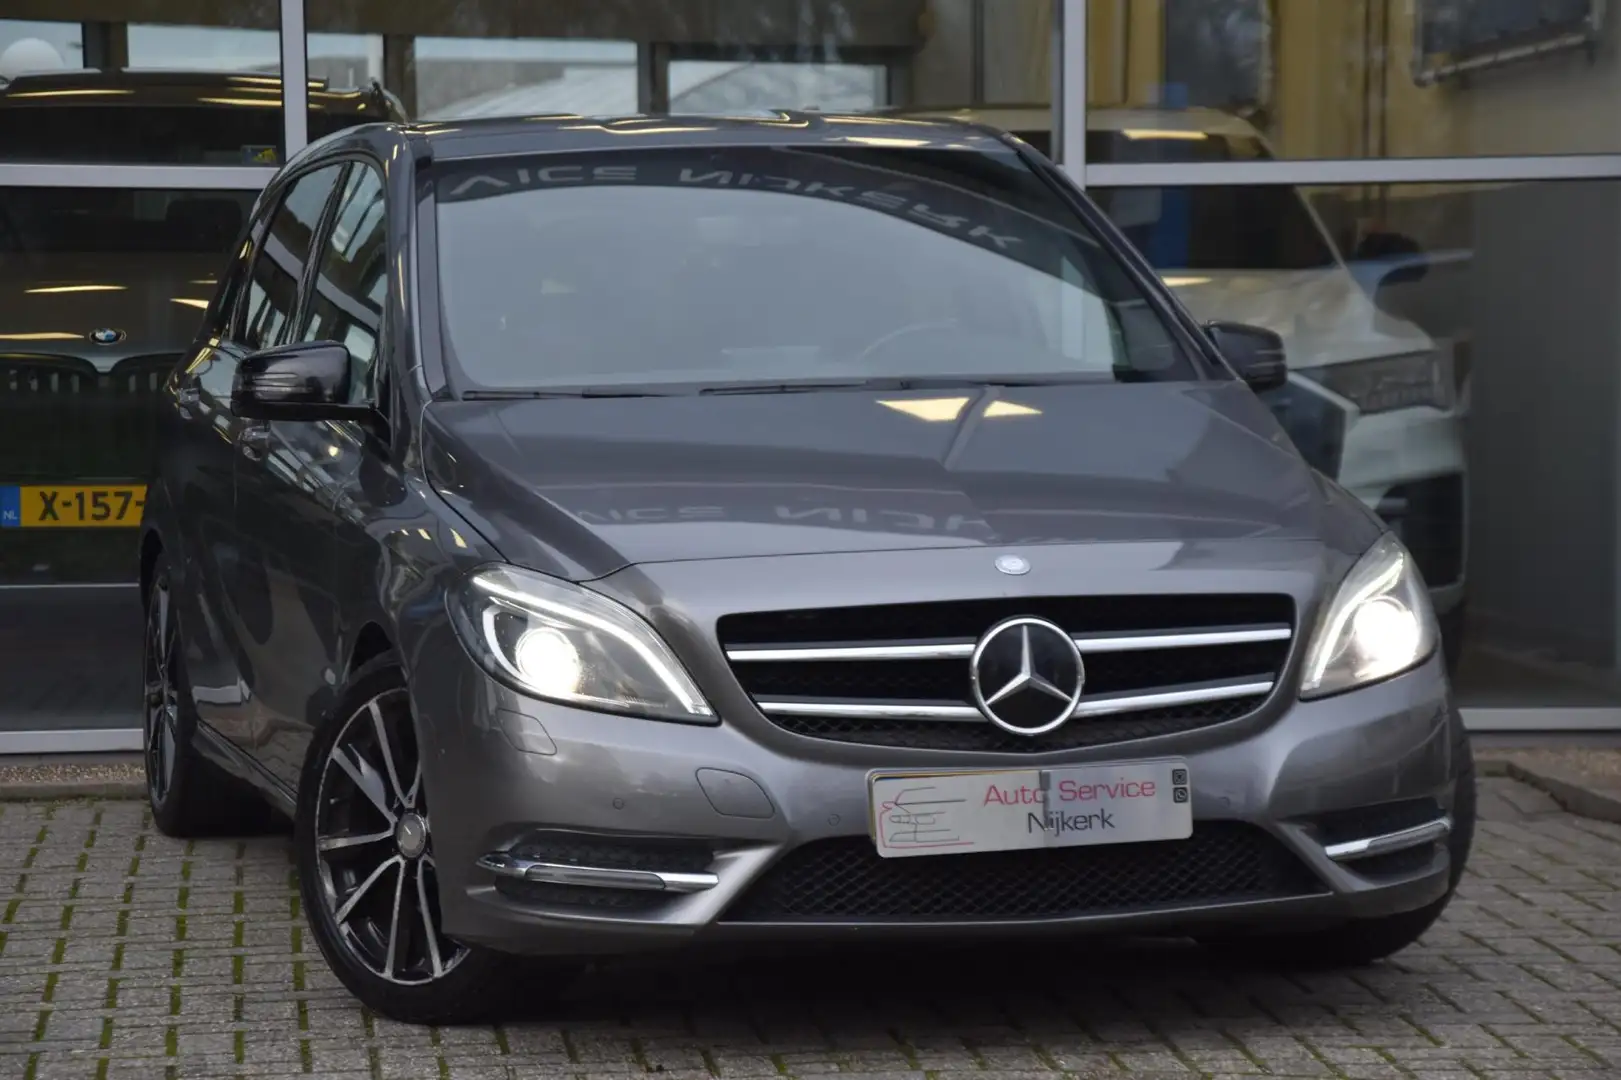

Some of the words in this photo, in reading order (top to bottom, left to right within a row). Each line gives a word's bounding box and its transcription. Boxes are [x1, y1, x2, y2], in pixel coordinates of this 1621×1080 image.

[3, 510, 17, 520] NL
[983, 784, 1047, 806] Auto
[1058, 777, 1156, 801] Service
[1027, 808, 1116, 837] Nijkerk
